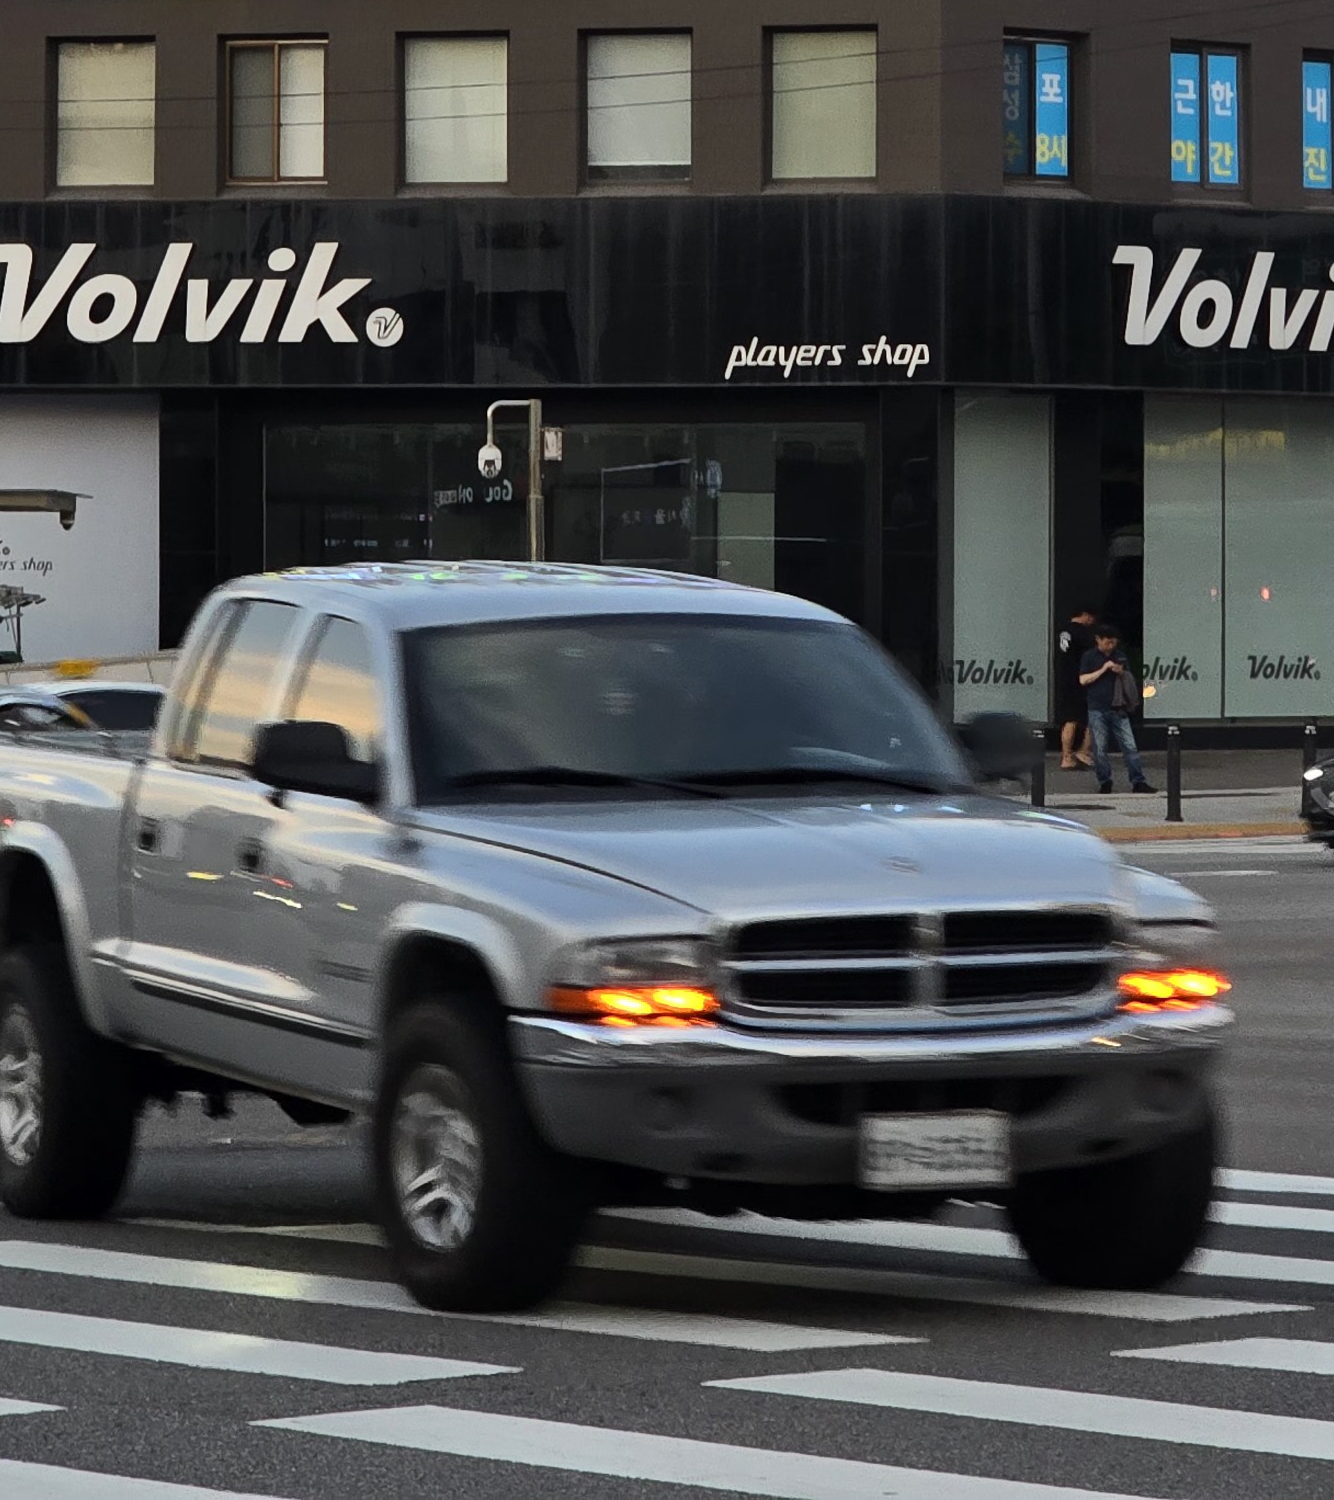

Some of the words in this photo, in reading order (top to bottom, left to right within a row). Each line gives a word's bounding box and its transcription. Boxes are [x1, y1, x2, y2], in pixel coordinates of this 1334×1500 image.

[725, 336, 842, 379] players
[858, 335, 930, 377] shop
[21, 557, 53, 576] shop
[955, 659, 1028, 684] Volvik
[1143, 656, 1193, 681] olvik
[1247, 655, 1316, 680] Volvik
